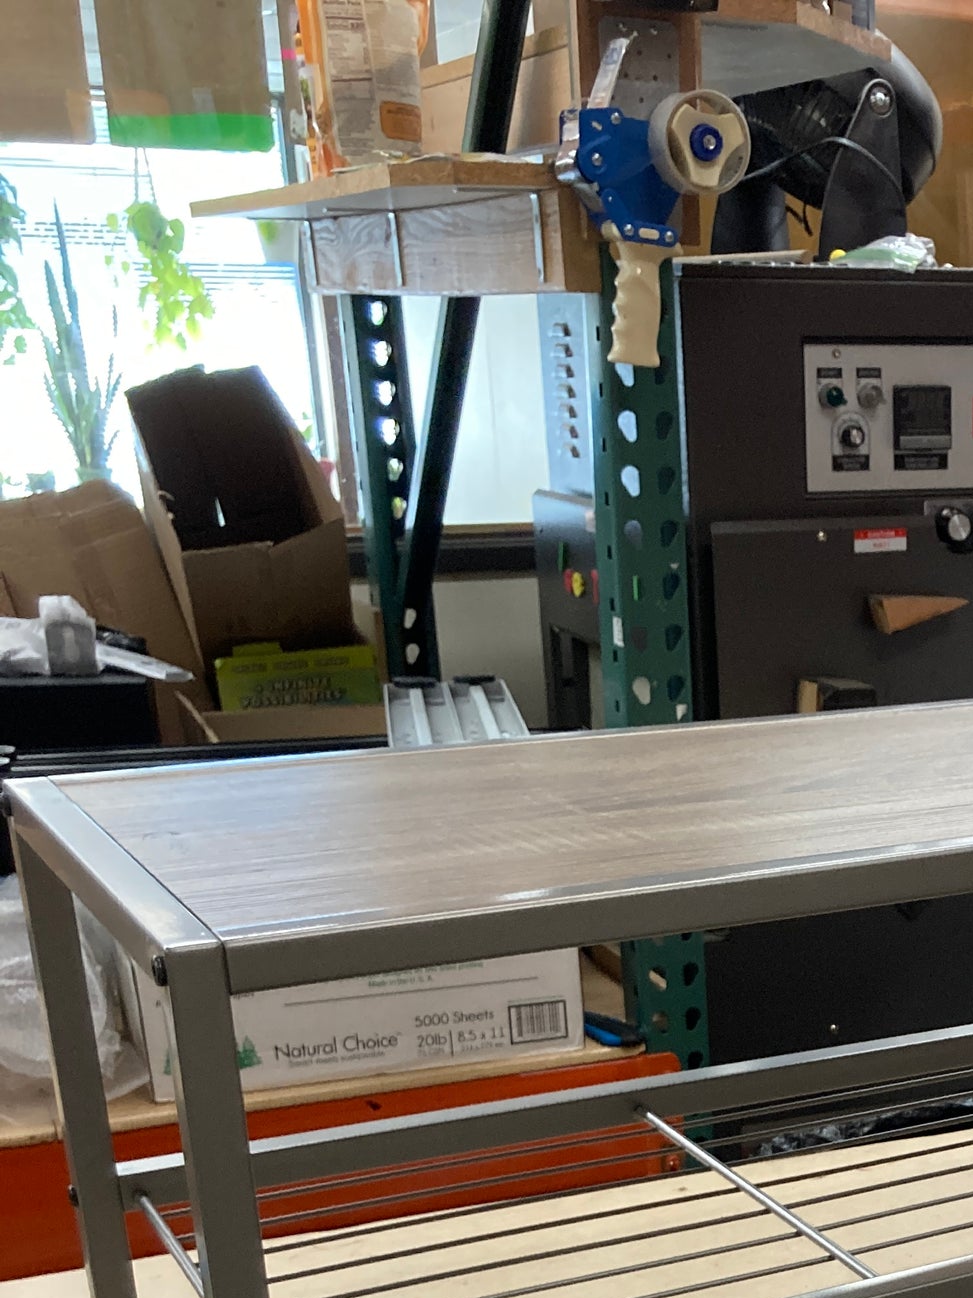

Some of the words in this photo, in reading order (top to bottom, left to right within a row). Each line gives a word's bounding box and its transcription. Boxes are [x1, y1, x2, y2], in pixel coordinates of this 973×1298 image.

[415, 1012, 449, 1028] 5000
[453, 1010, 495, 1024] Sheets
[416, 1032, 448, 1048] 20lb
[457, 1029, 478, 1043] 8.5
[492, 1026, 505, 1039] 11
[274, 1034, 338, 1060] Natural
[343, 1032, 399, 1052] Choice
